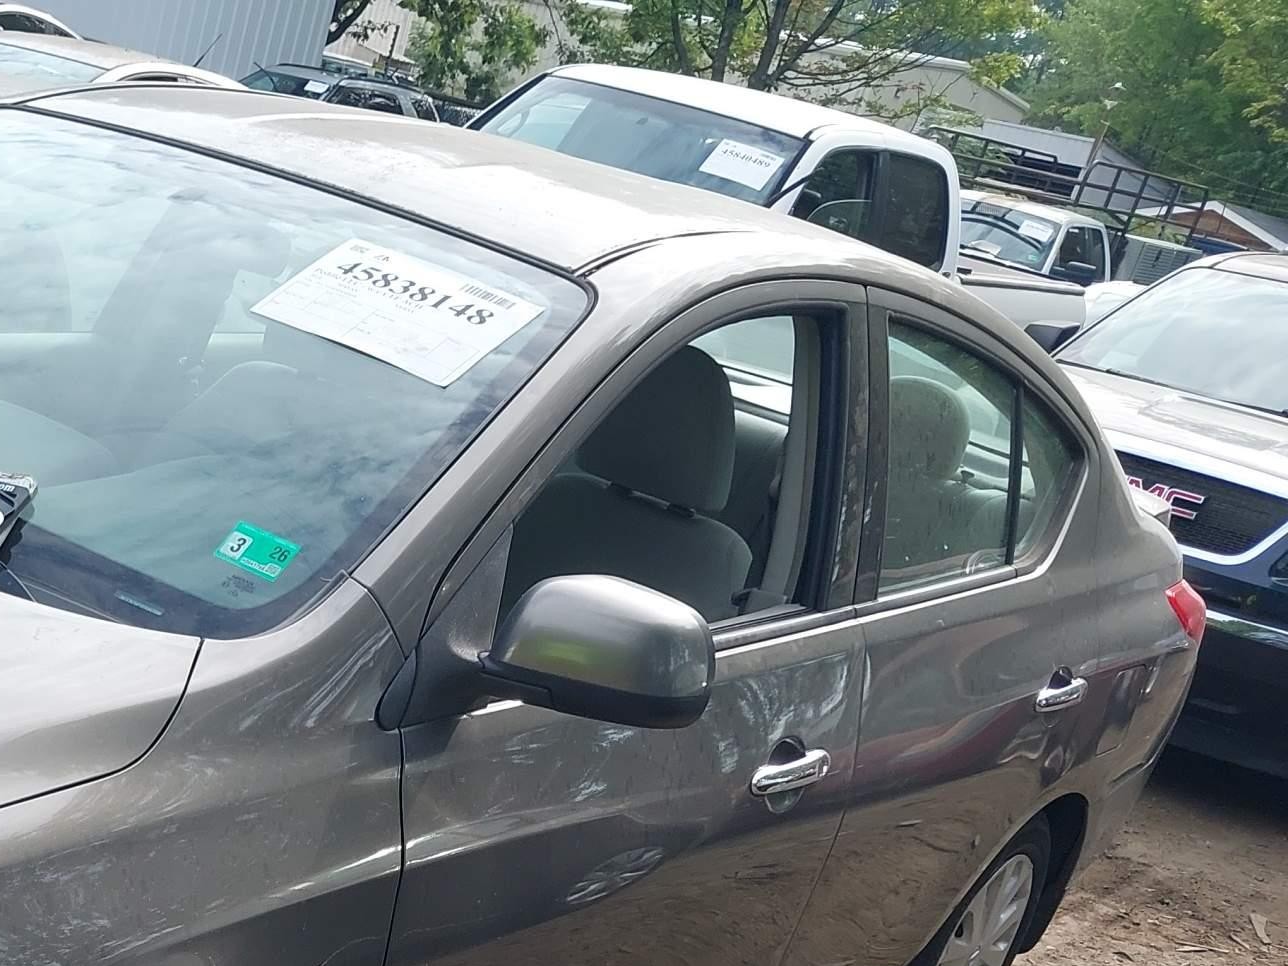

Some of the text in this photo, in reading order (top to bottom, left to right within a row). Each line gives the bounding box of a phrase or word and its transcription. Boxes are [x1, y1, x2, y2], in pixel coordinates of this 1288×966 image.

[721, 148, 772, 168] 45840489
[336, 261, 495, 326] 45838148
[229, 537, 247, 553] 3
[268, 545, 291, 563] 26
